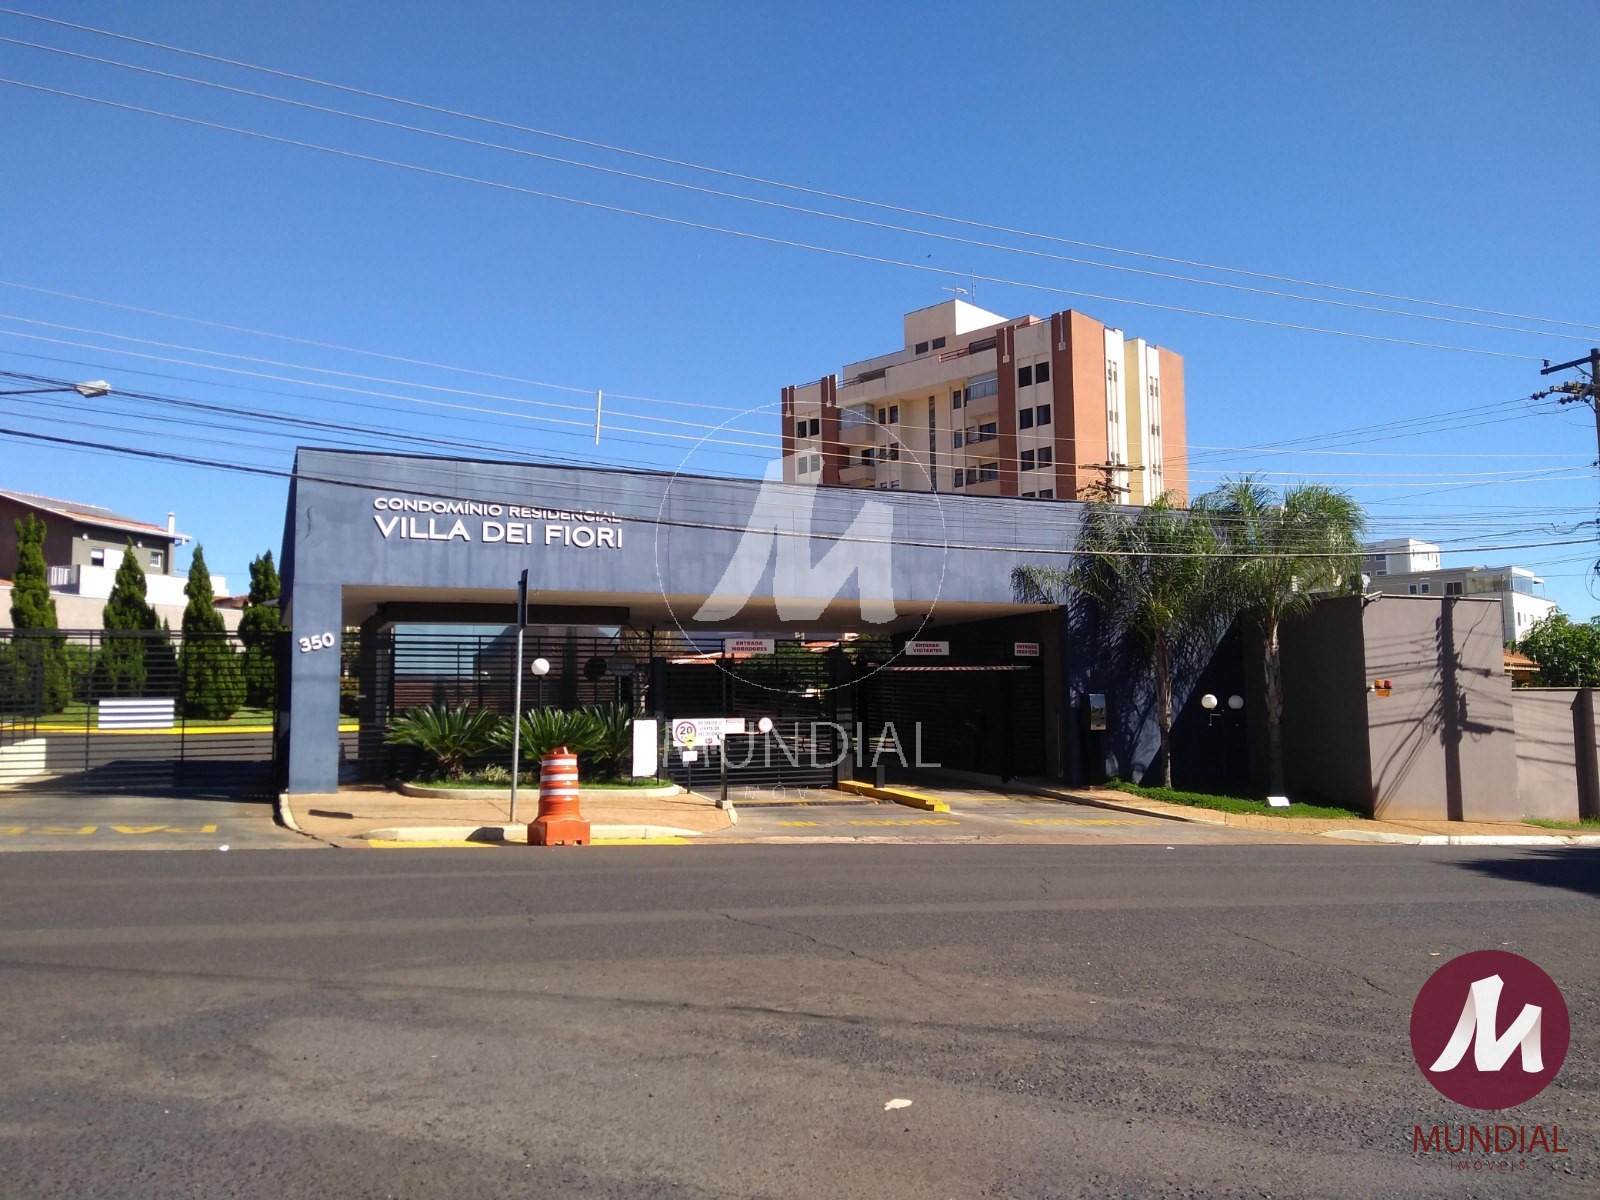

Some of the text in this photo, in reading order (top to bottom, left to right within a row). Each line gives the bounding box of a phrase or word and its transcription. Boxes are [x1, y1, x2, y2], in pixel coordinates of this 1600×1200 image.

[373, 498, 622, 523] CONDOMÍNIO RESIDENCIAL
[373, 515, 623, 549] VILLA DEI FIORI
[299, 632, 335, 653] 350
[679, 726, 693, 735] 20
